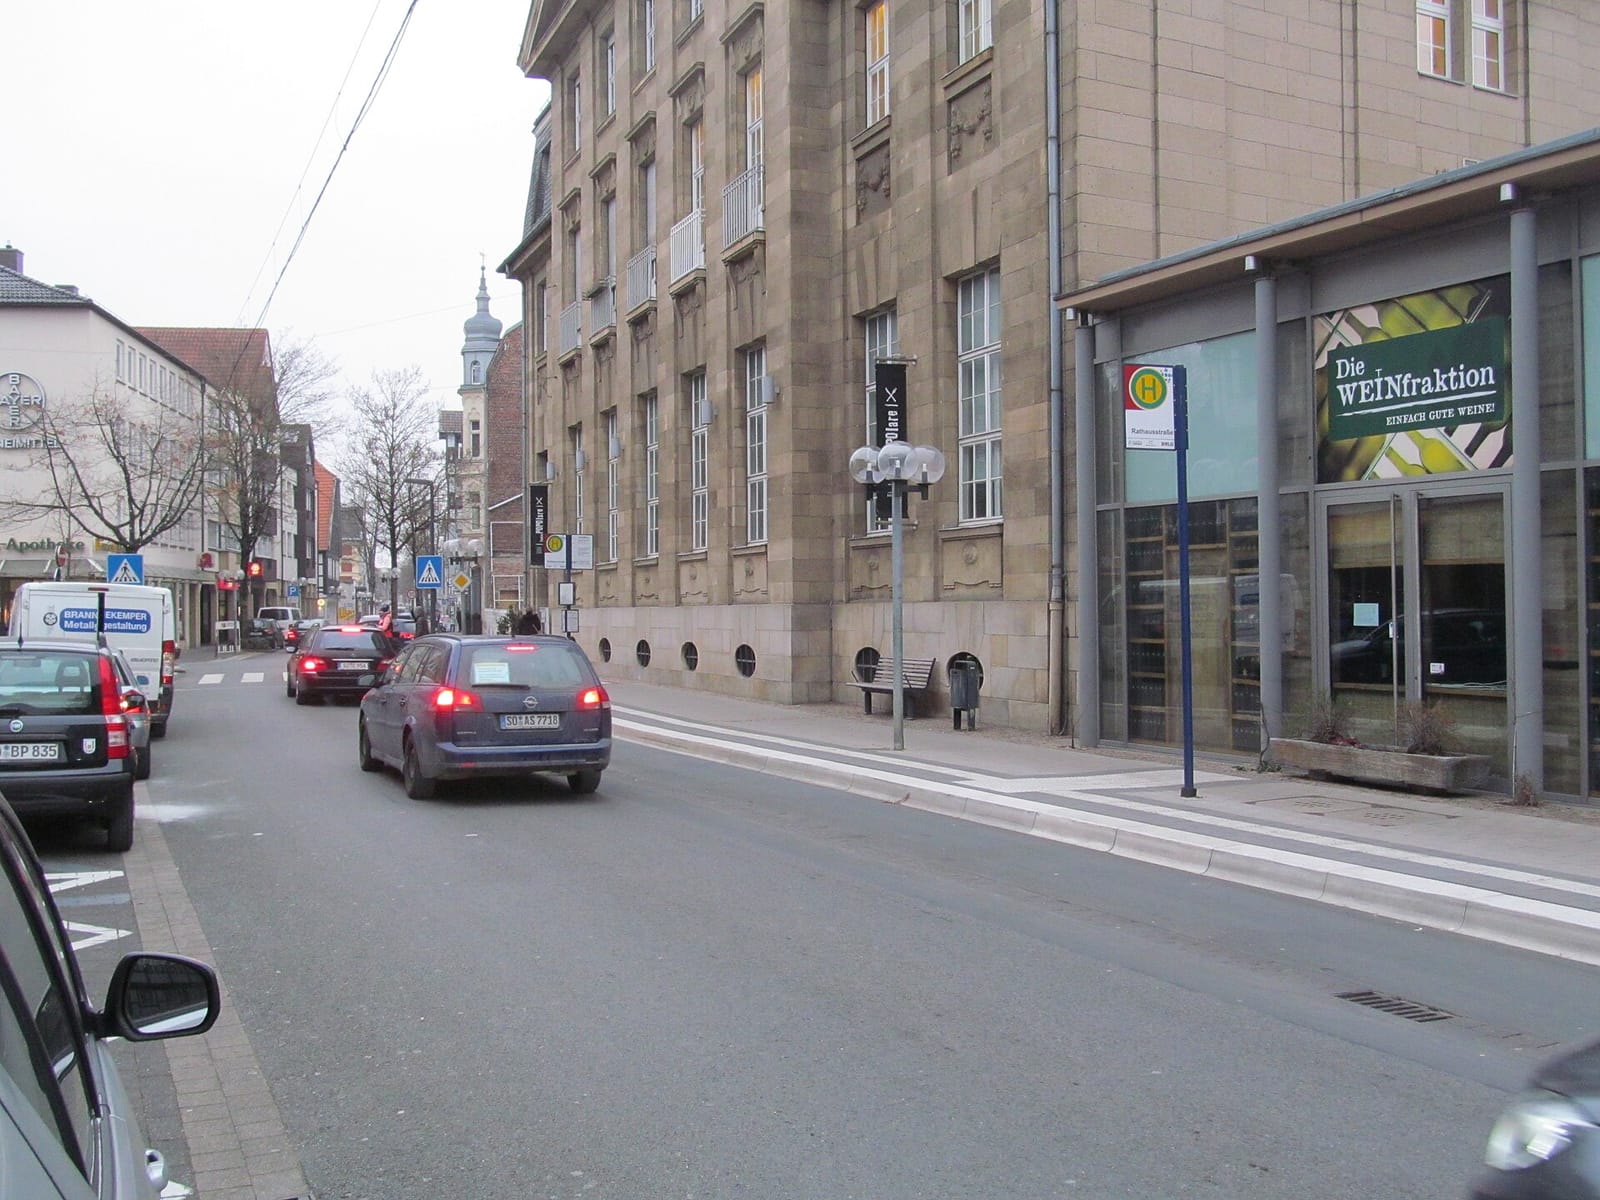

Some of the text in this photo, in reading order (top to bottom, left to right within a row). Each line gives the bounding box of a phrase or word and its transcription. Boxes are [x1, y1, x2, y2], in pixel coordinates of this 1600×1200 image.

[1336, 357, 1365, 379] Die
[1141, 376, 1157, 401] H
[1336, 364, 1495, 407] WEINfraktion
[0, 395, 42, 406] AYER
[9, 374, 20, 427] BAYER
[1386, 403, 1496, 427] EINFACH GUTE WEINE!
[0, 439, 61, 449] EIMITTEL
[506, 715, 558, 726] SO AS 7718
[11, 745, 29, 758] BP
[32, 744, 57, 758] 835
